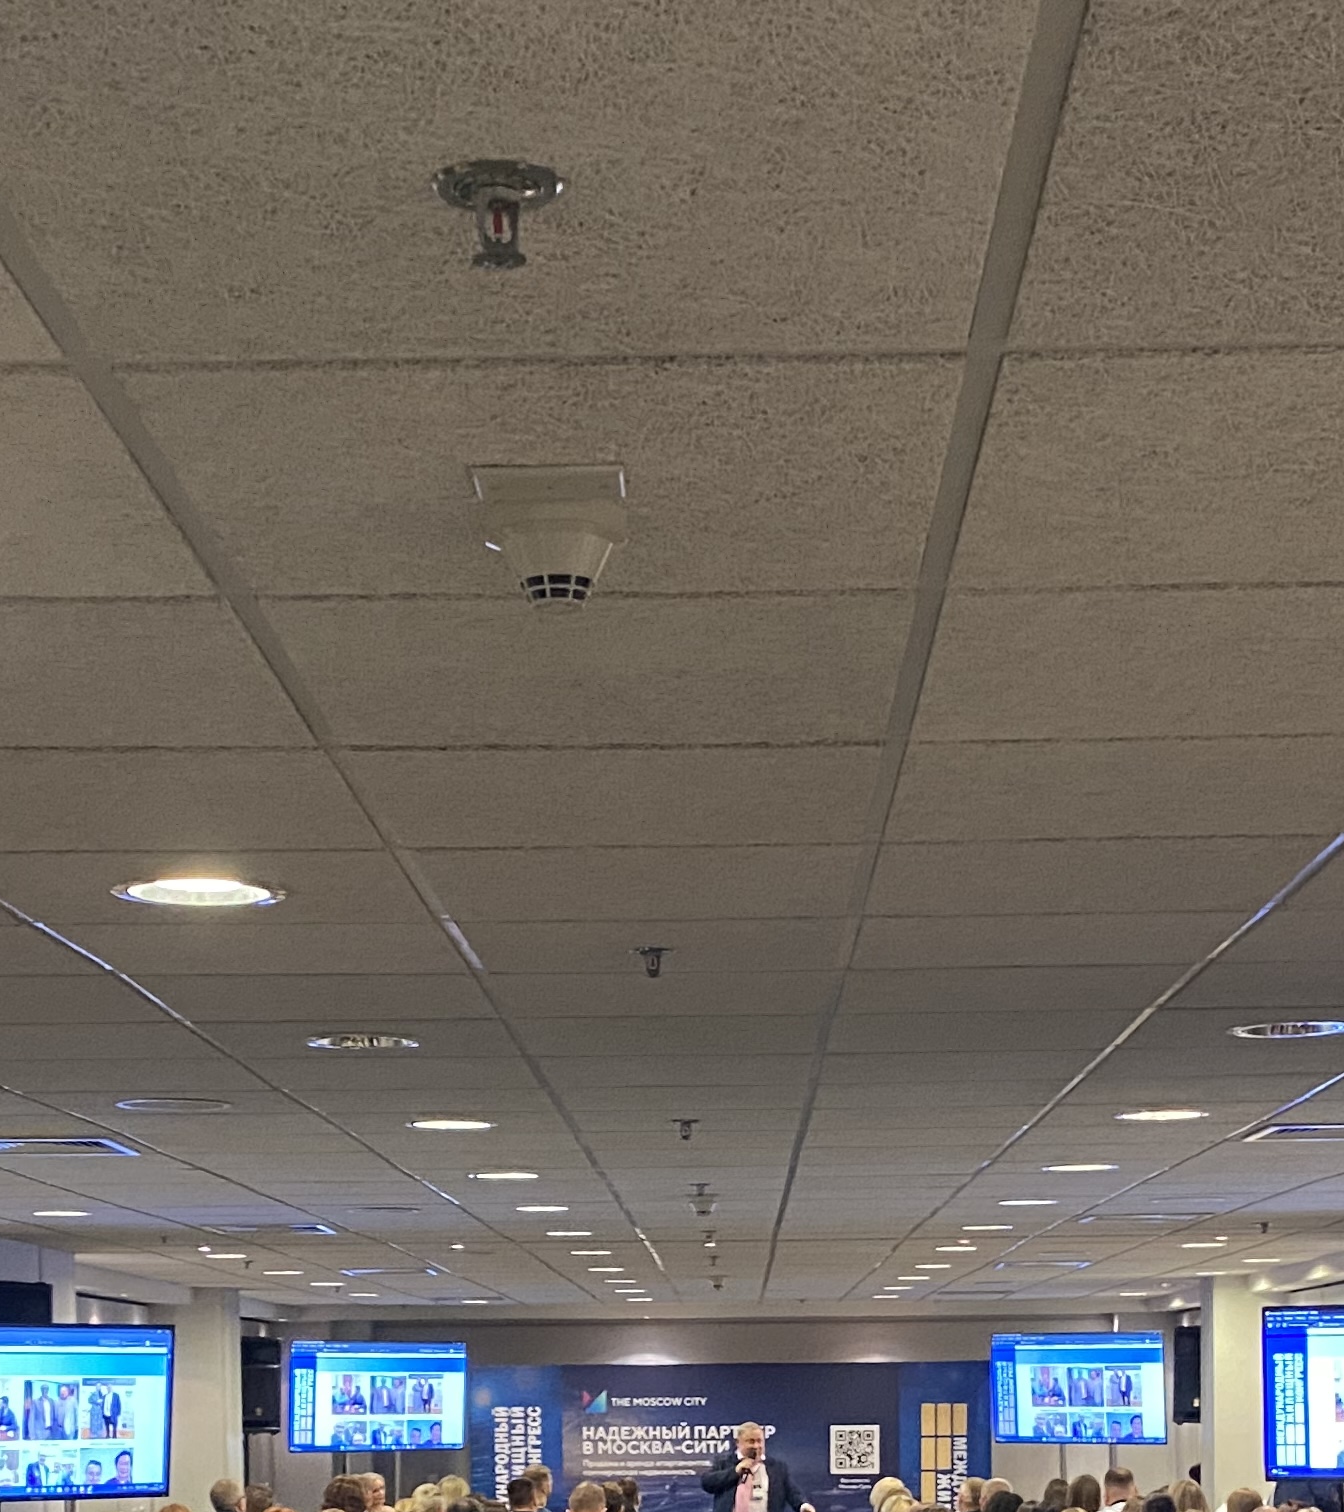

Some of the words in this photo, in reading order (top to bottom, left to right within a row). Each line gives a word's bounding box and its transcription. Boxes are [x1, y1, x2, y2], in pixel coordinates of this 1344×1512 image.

[611, 1397, 630, 1407] THE
[633, 1397, 682, 1407] MOSCOW
[683, 1397, 707, 1407] CITY
[527, 1406, 542, 1464] НГРЕСС
[582, 1421, 690, 1442] НАДЕЖНЫЙ
[694, 1425, 777, 1440] ПАРТР
[509, 1406, 528, 1480] ИЩНЫЙ
[582, 1441, 594, 1455] В
[597, 1440, 731, 1455] МОСКВА-СИТИ
